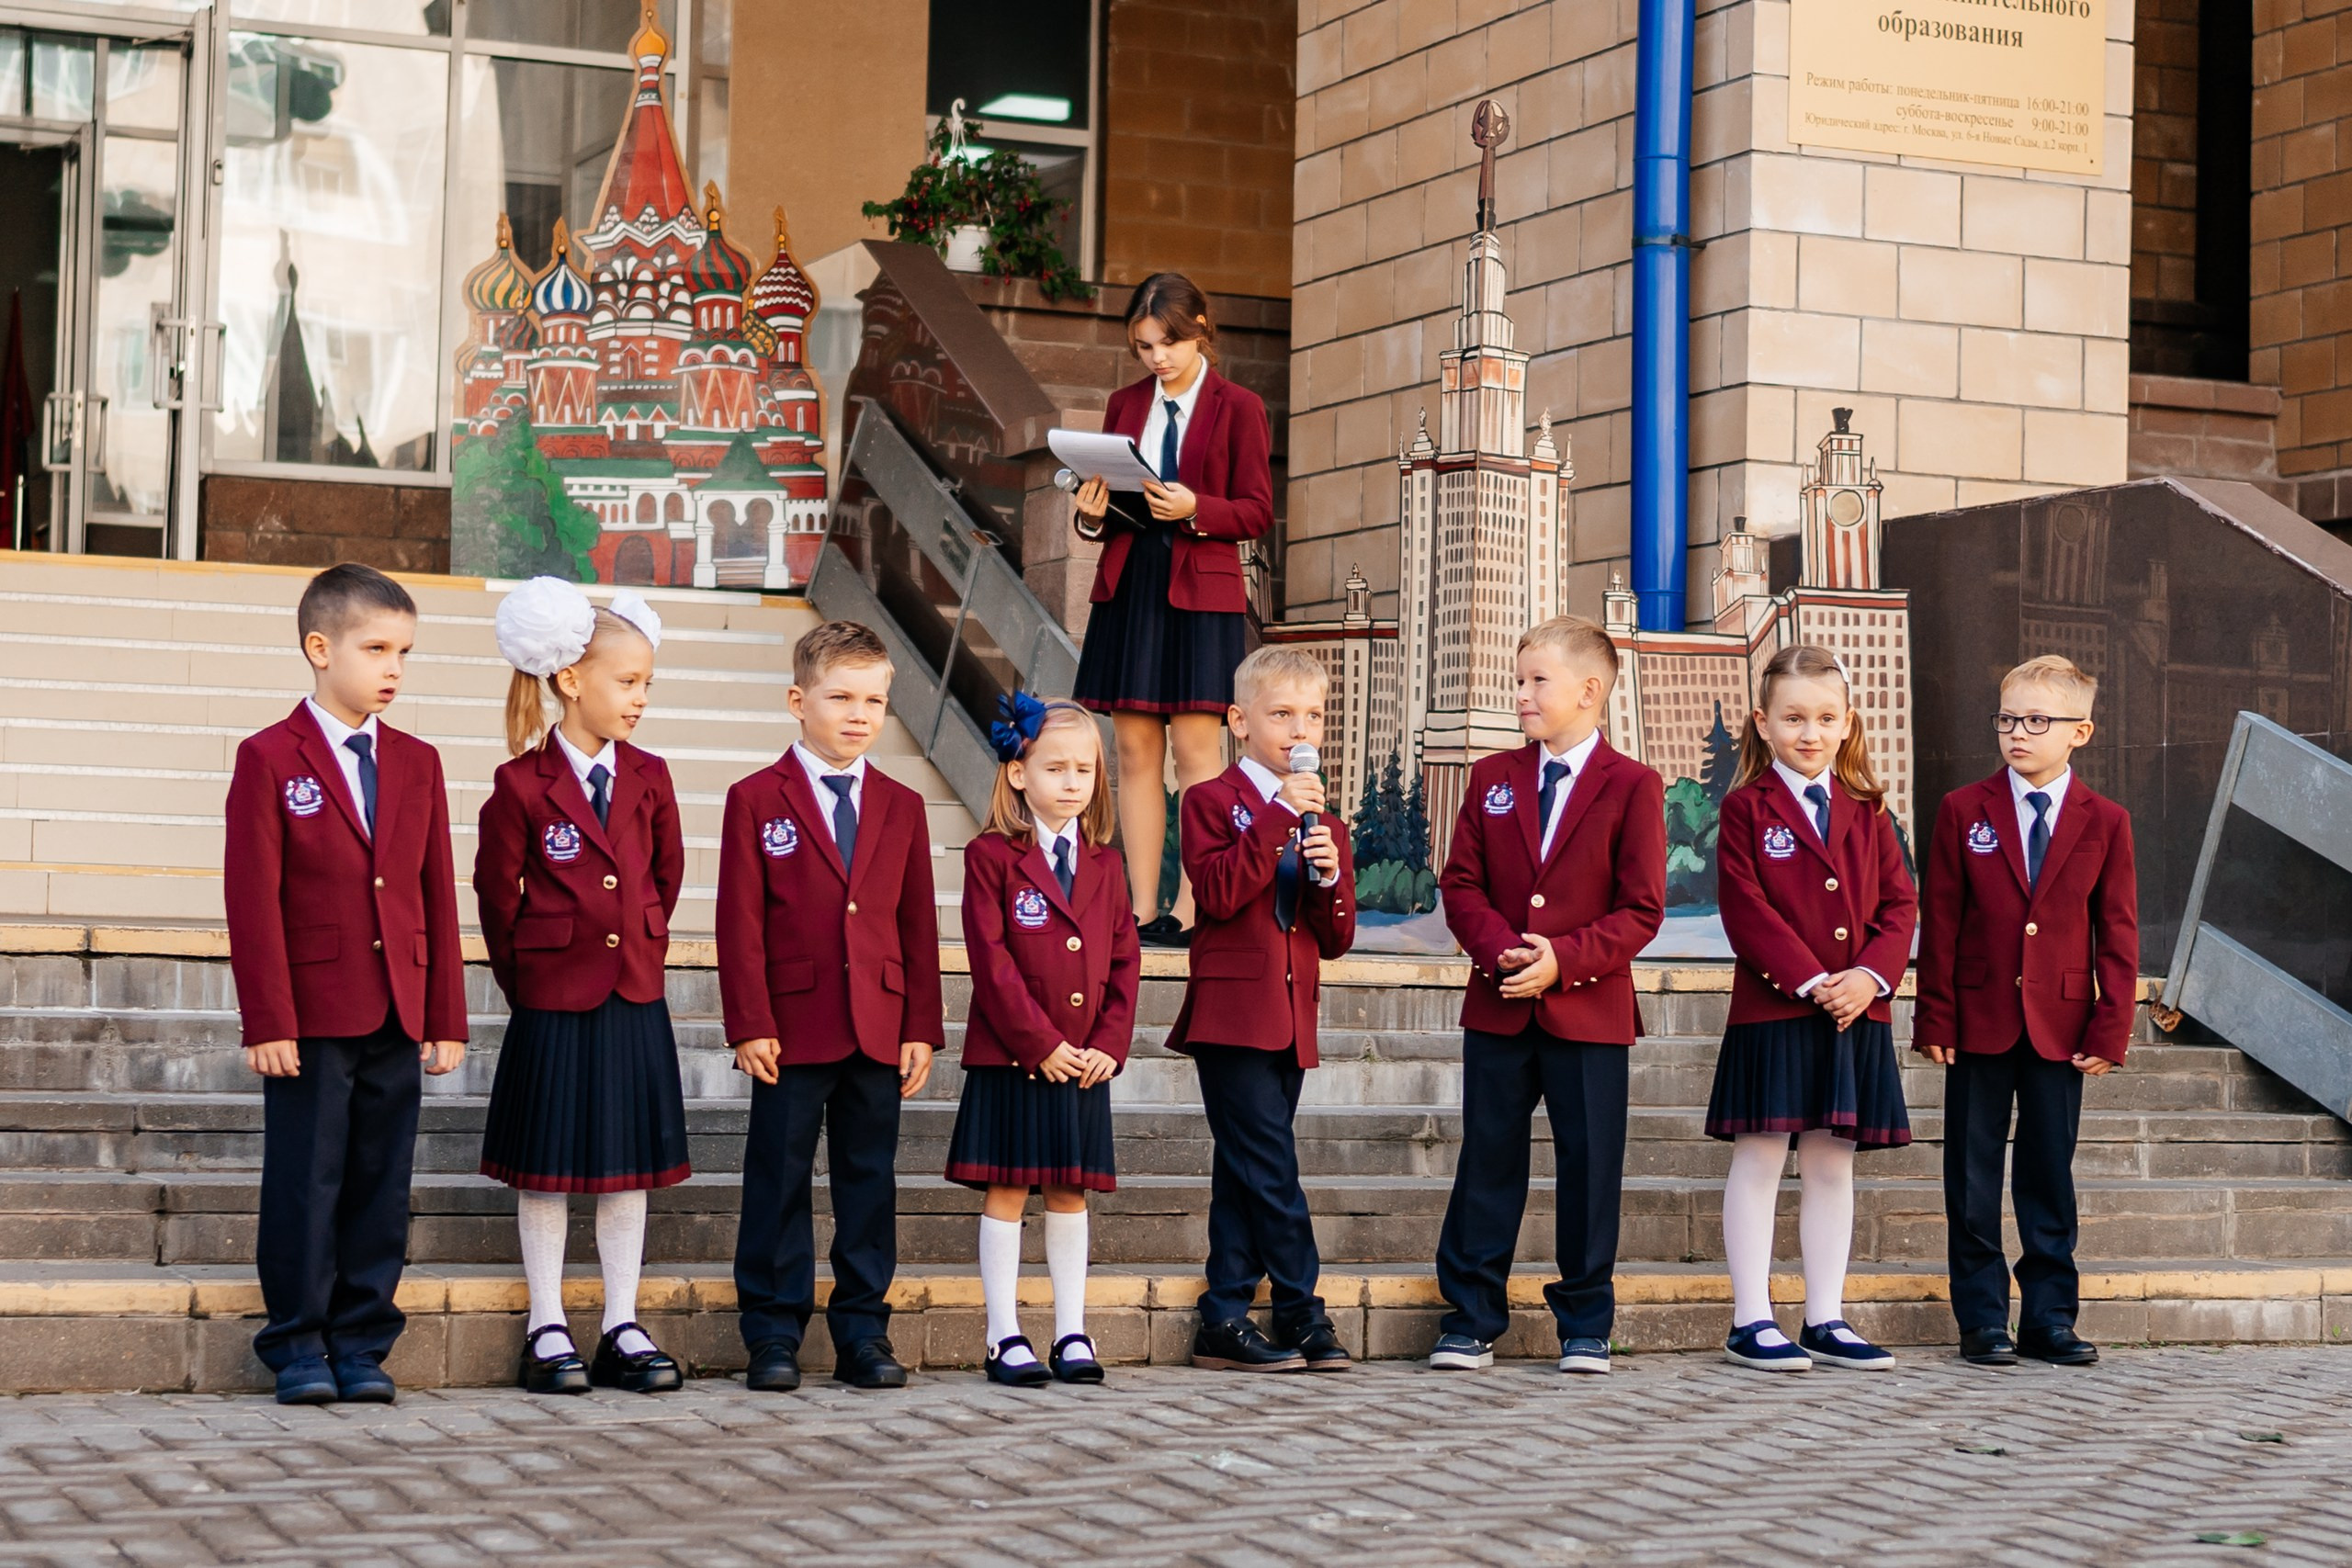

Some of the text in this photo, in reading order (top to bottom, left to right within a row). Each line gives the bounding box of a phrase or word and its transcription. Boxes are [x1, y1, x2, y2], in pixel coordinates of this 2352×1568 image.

[1879, 10, 2024, 48] образования
[1806, 72, 2089, 116] Режим работы: понедельник-пятница 16:00-21:00
[1804, 112, 1871, 128] Юридический
[1895, 104, 2089, 137] суббота-воскресенье 9:00-21:00
